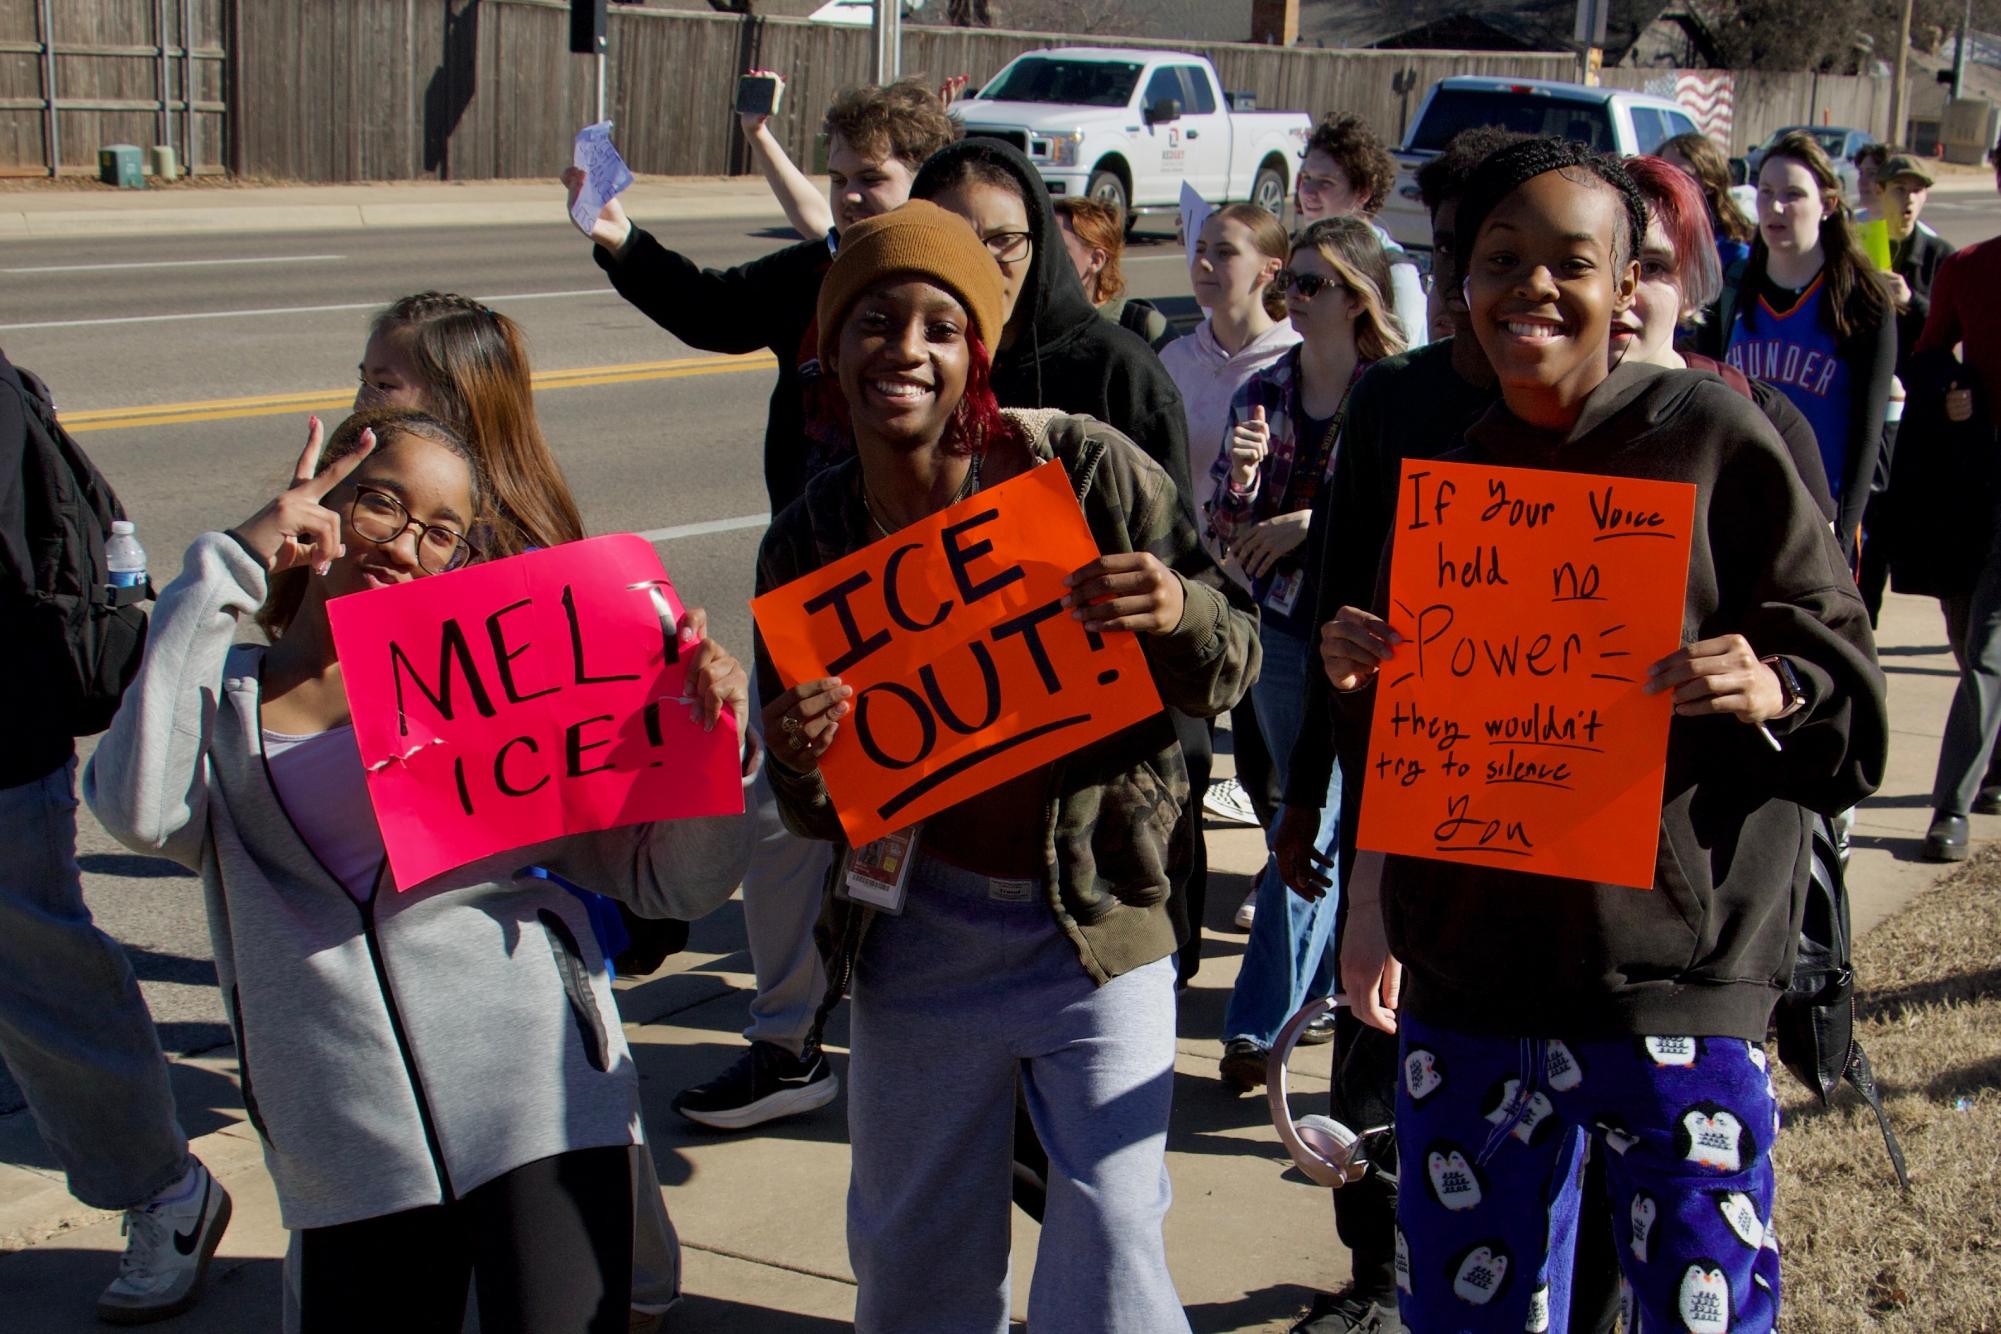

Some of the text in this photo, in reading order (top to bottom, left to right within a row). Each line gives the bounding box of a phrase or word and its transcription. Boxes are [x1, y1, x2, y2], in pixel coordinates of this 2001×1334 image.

[1724, 341, 1838, 396] HUNDER
[1407, 471, 1456, 530] If
[1588, 486, 1665, 531] Voice
[803, 508, 1026, 677] ICE
[1438, 542, 1601, 599] held no
[389, 580, 681, 737] MELT
[1418, 604, 1581, 679] Power
[854, 598, 1120, 771] OUT!
[454, 700, 665, 816] ICE!
[1391, 702, 1604, 752] they wouldn't
[1375, 749, 1571, 787] try to silence
